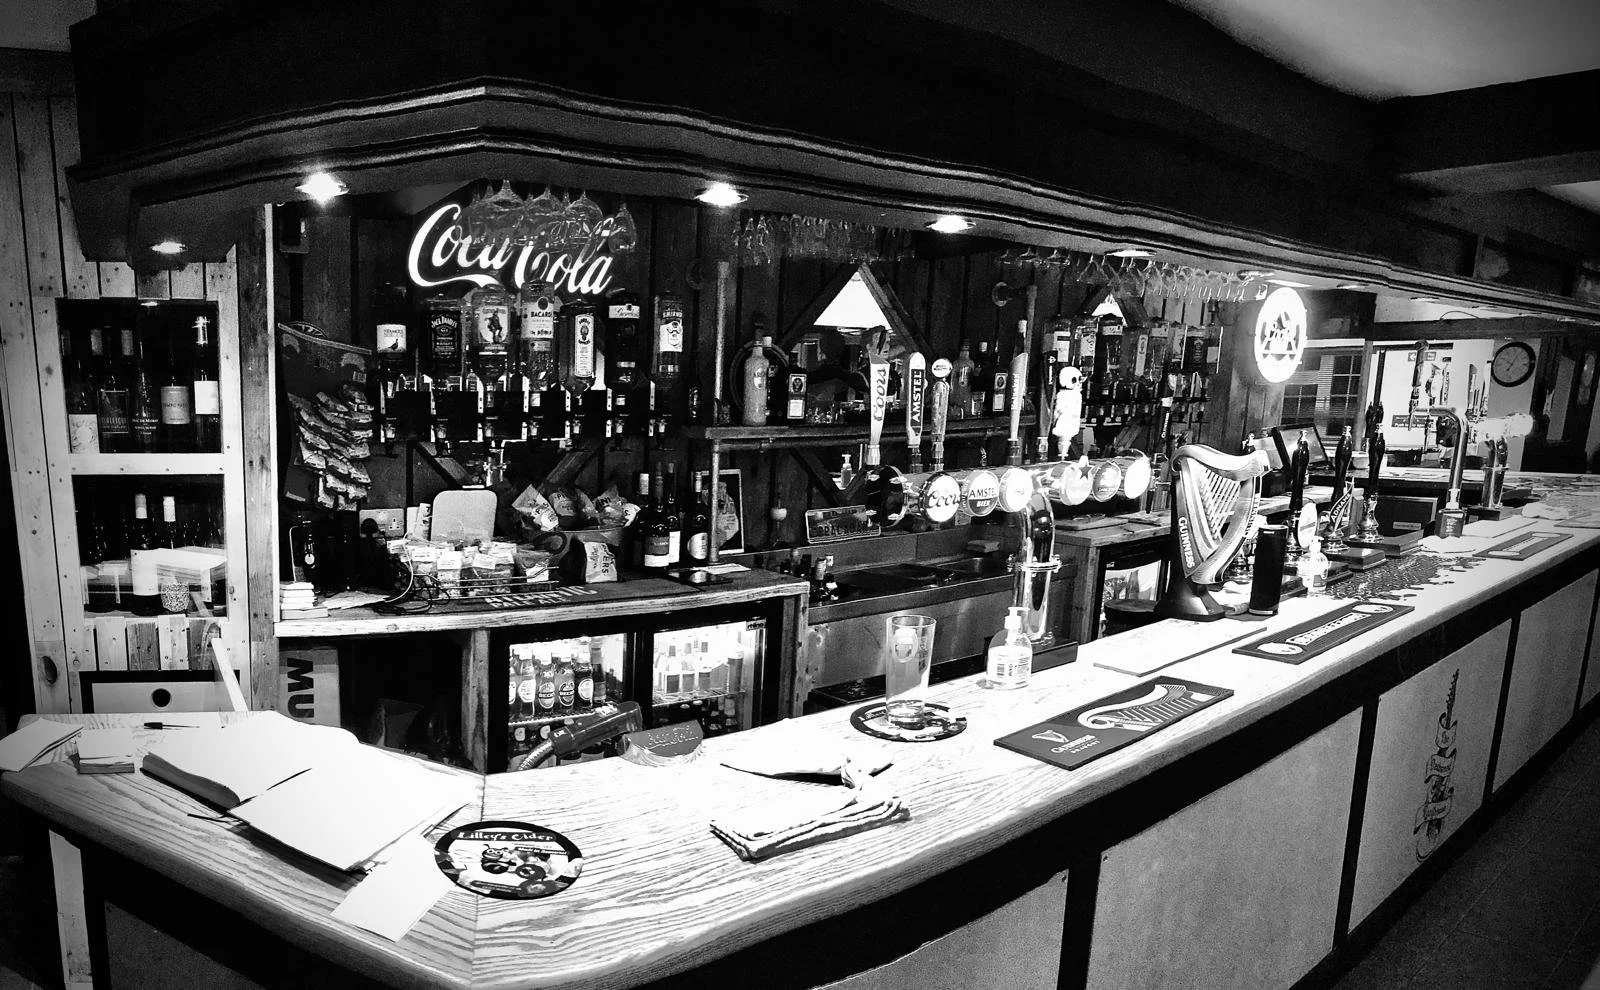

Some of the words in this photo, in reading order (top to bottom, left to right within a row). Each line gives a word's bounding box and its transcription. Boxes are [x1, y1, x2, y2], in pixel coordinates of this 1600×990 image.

[873, 367, 888, 421] Coors
[911, 370, 923, 423] AMSTEL
[1178, 516, 1196, 569] GUINNESS
[286, 657, 315, 719] MU
[457, 831, 508, 841] Lilley's
[511, 832, 554, 841] Cider
